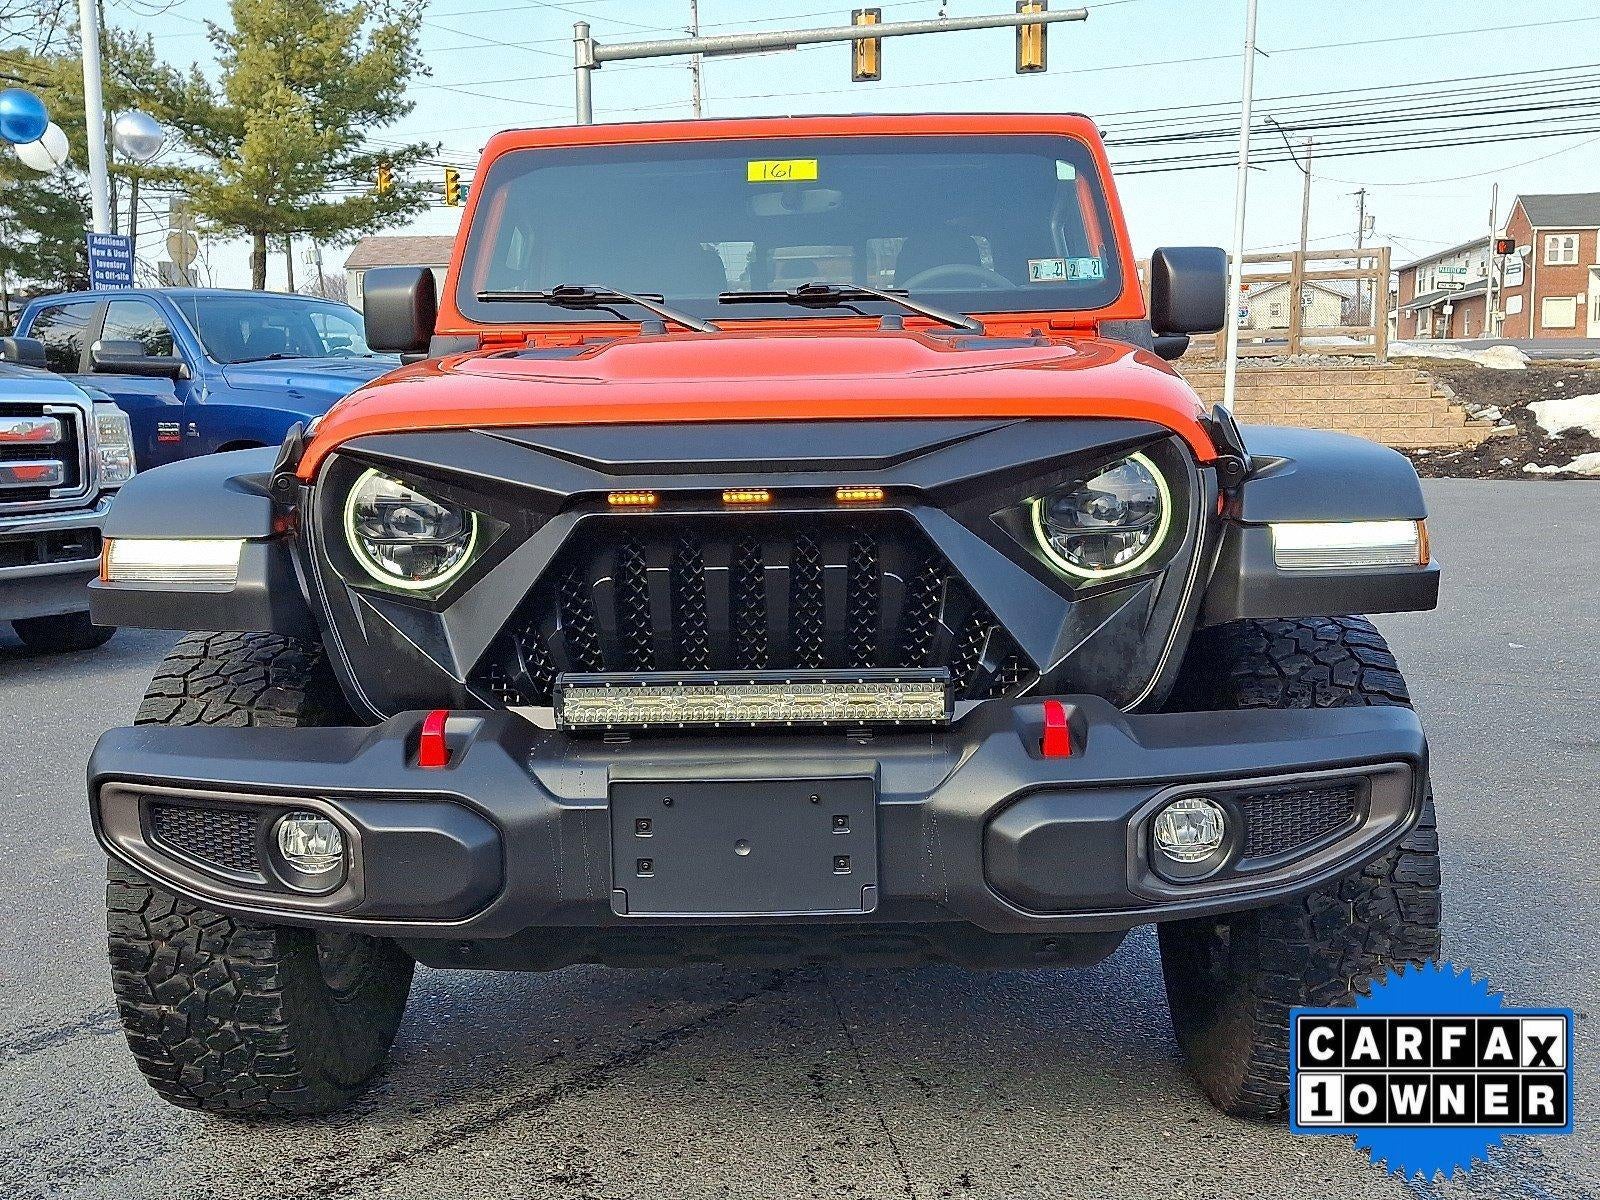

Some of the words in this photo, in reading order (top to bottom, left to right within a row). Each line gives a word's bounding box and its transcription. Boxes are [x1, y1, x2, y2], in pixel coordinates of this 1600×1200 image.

[763, 164, 792, 178] 161
[93, 236, 126, 247] Additional
[92, 248, 106, 257] New
[106, 249, 113, 257] &
[113, 249, 129, 258] Used
[96, 260, 127, 270] Inventory
[1070, 263, 1077, 277] 2
[95, 271, 104, 279] On
[105, 271, 130, 280] Off-site
[1033, 266, 1039, 279] 2
